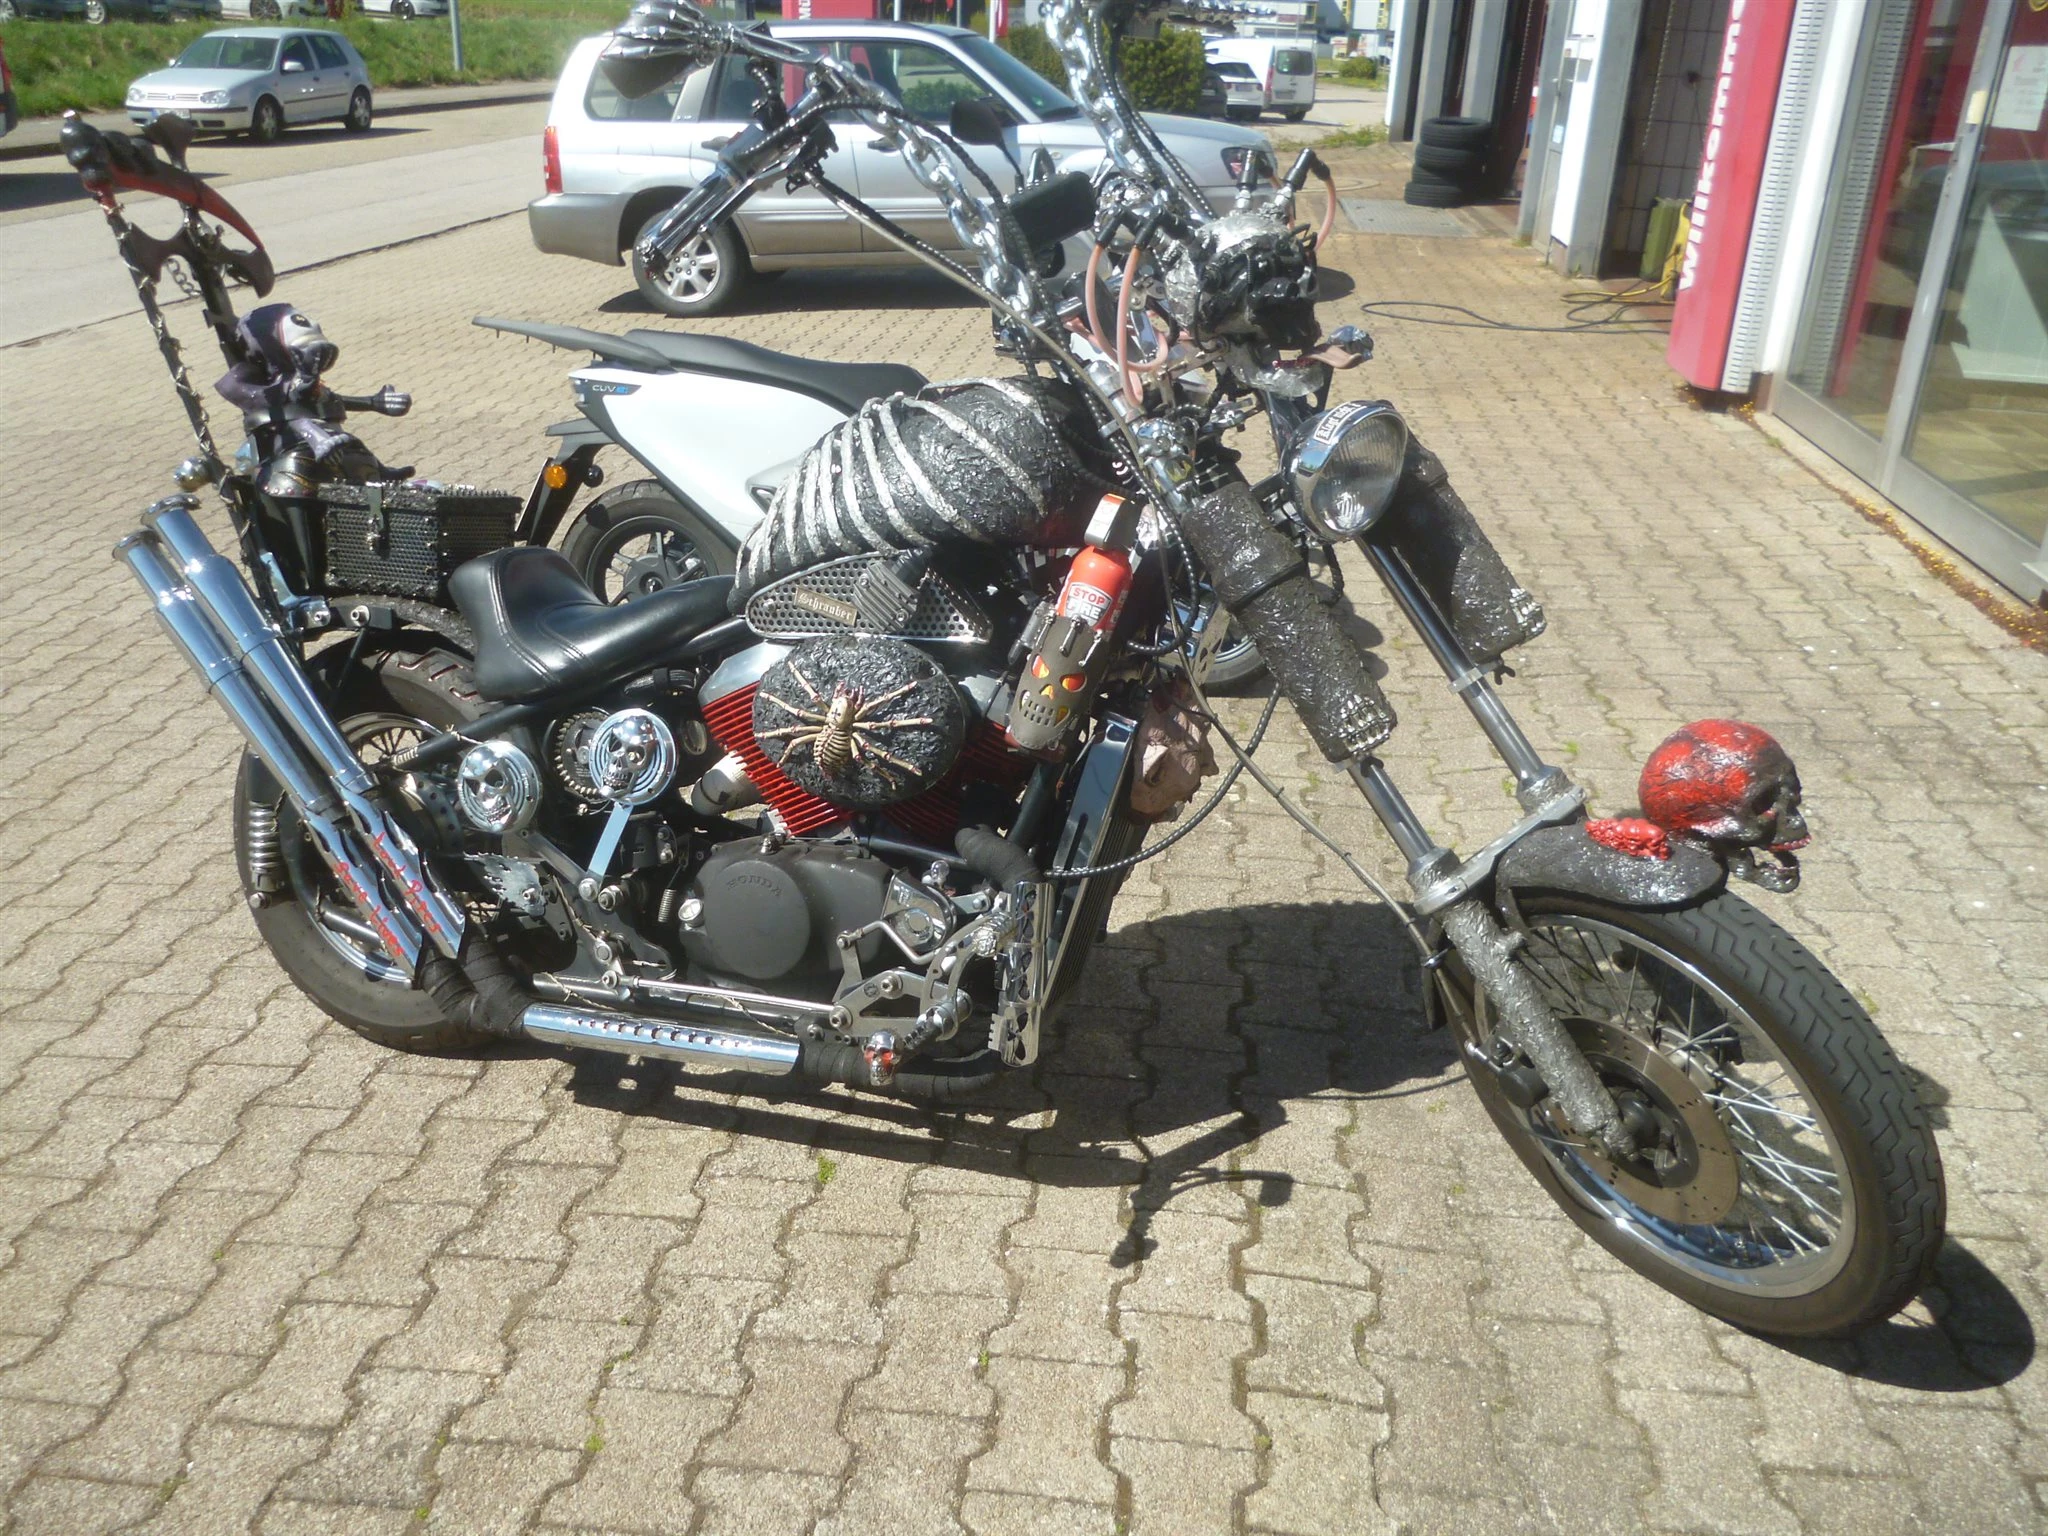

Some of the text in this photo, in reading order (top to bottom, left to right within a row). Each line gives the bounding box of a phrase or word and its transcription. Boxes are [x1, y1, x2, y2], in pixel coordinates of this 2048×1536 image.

[798, 592, 853, 620] Schrauber
[1073, 587, 1106, 606] STOP
[726, 875, 784, 896] HONDA
